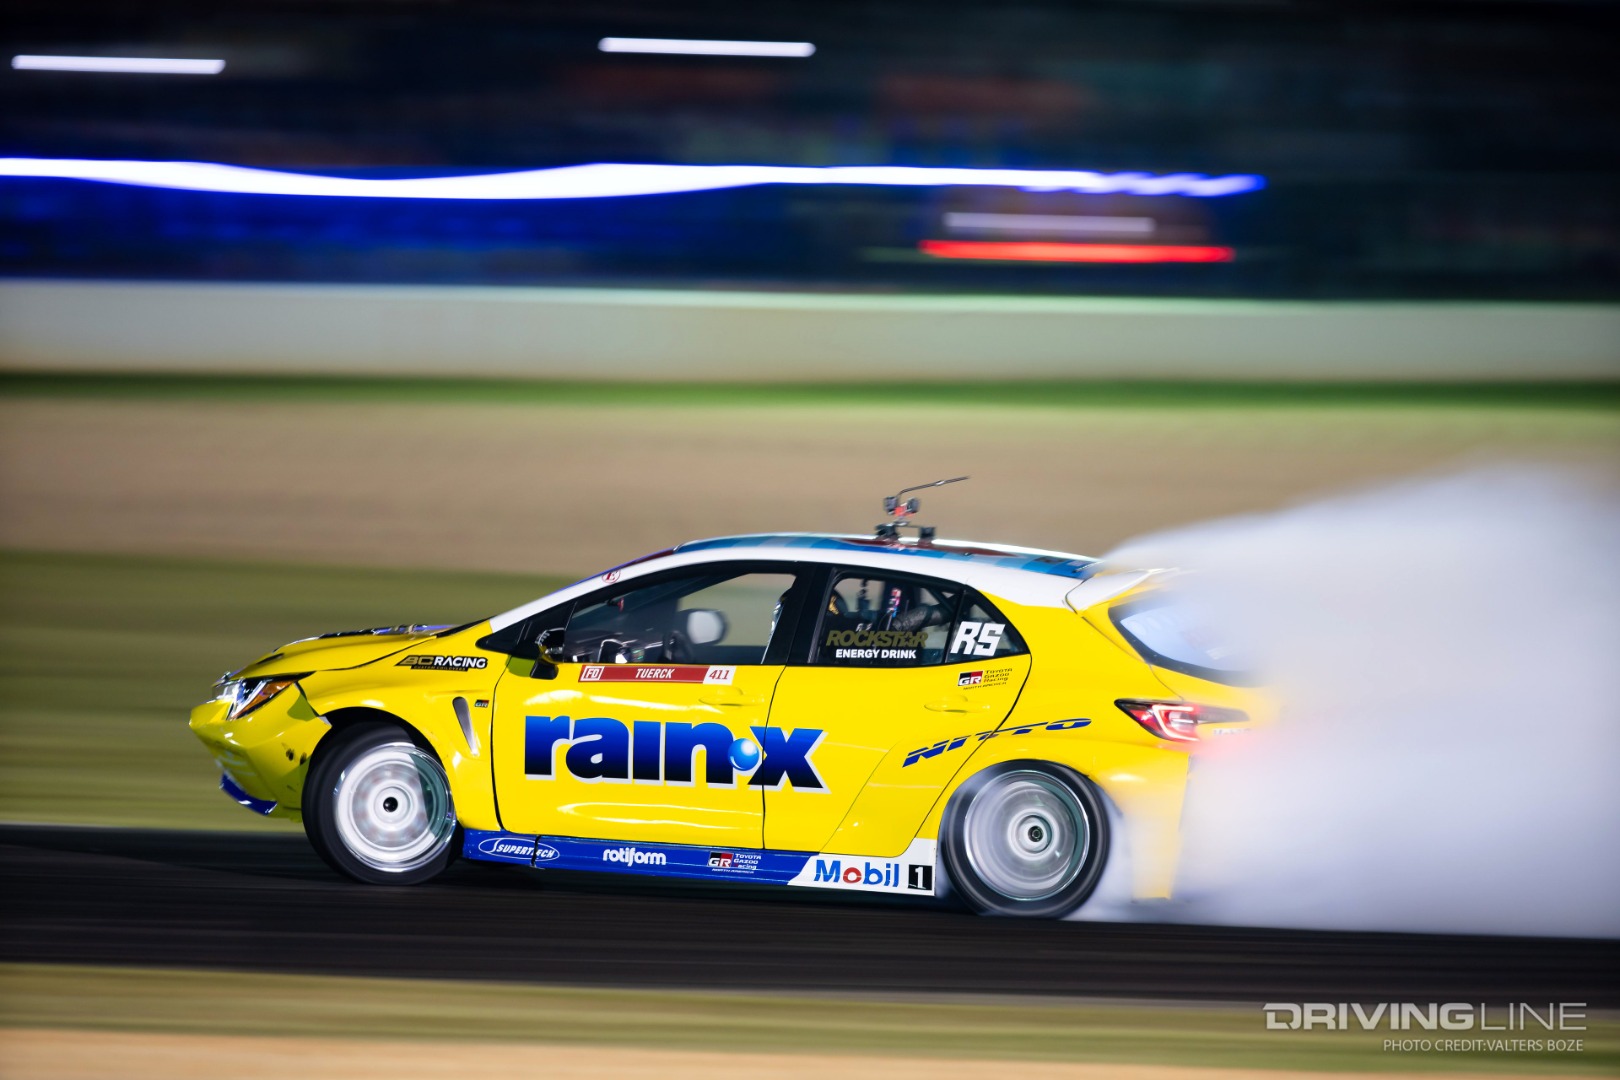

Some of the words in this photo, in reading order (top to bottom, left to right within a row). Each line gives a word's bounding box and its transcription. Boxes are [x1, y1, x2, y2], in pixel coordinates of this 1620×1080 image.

[826, 629, 928, 648] ROCKSTAR
[950, 621, 1006, 657] RS
[835, 649, 880, 659] ENERGY
[881, 649, 917, 659] DRINK
[584, 668, 601, 679] FD
[635, 668, 675, 679] TUERCK
[708, 669, 730, 680] 411
[958, 676, 982, 687] GR
[902, 718, 1092, 768] NITTO
[602, 847, 667, 867] rotiform
[708, 858, 732, 868] GR
[813, 859, 900, 887] Mobil
